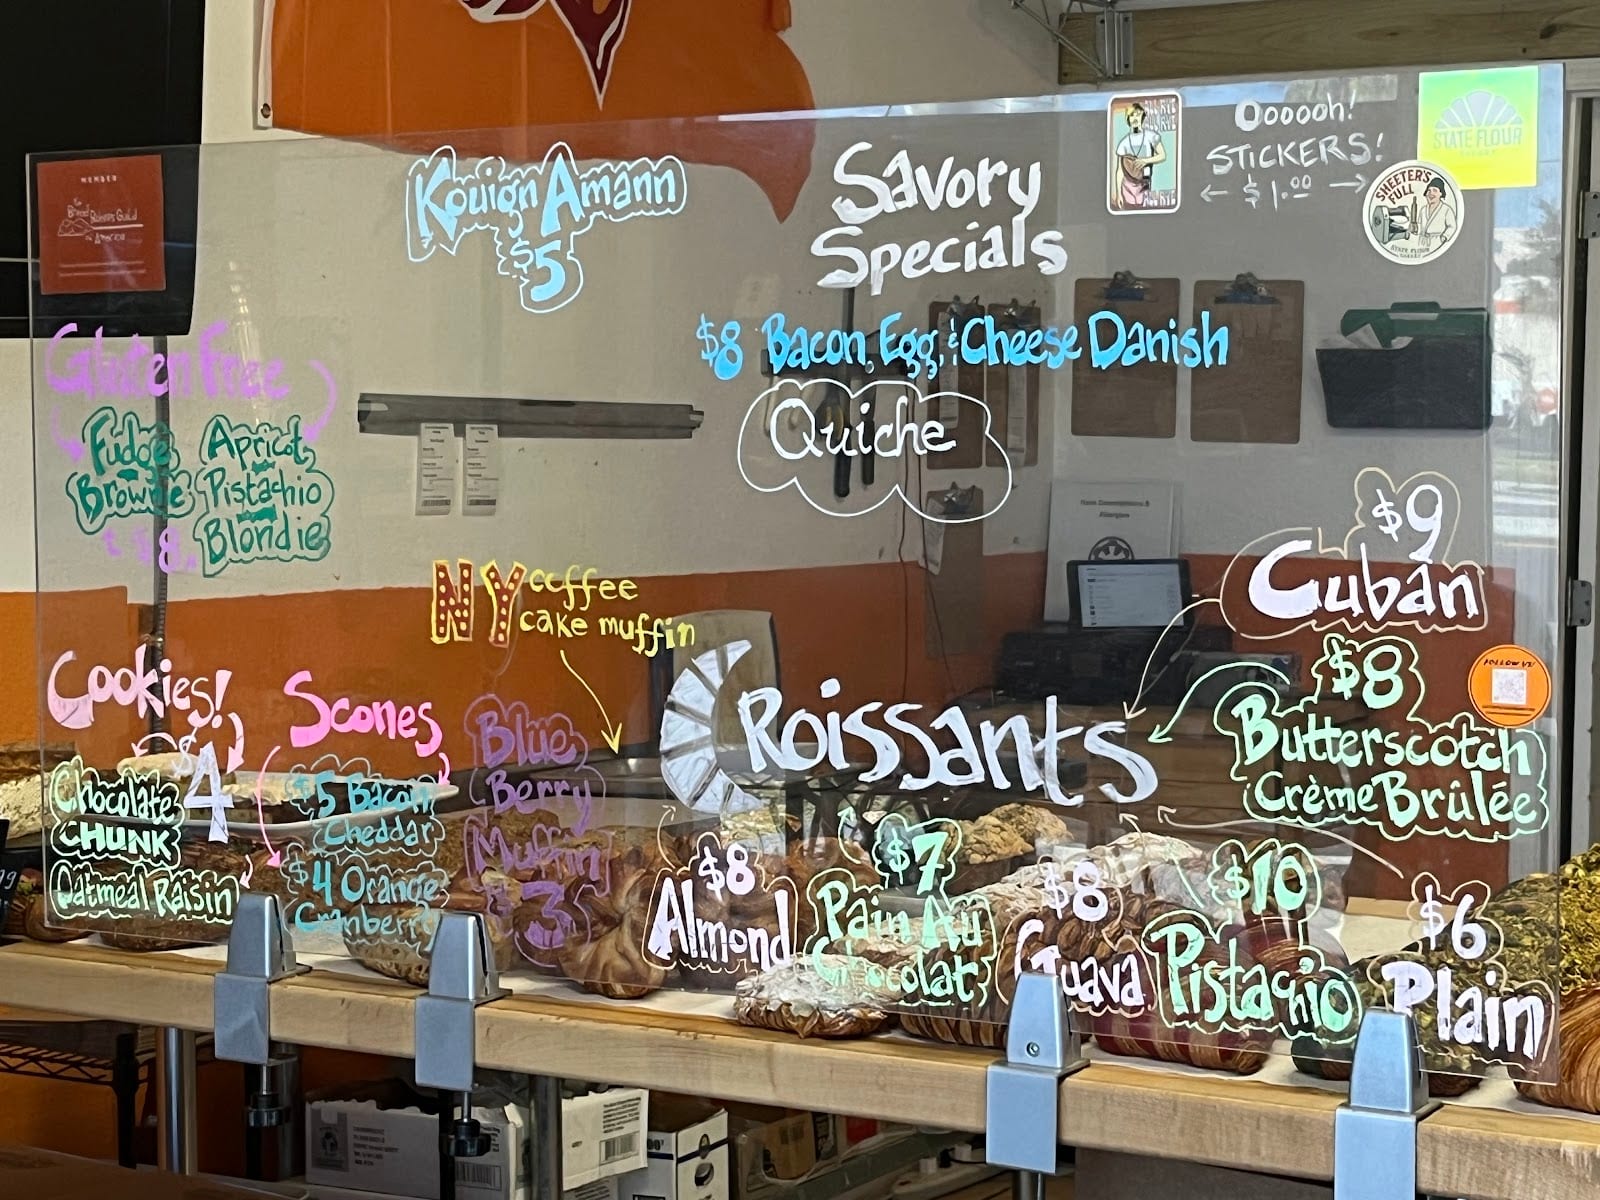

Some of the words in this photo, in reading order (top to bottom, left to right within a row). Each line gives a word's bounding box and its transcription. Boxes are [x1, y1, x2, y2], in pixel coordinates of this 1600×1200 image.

[1433, 129, 1473, 150] STATE
[1476, 126, 1522, 148] FLOUR
[414, 157, 538, 248] Kouign
[540, 153, 677, 237] Amann
[832, 141, 1042, 225] Savory
[1388, 184, 1414, 205] FULL
[510, 239, 566, 302] $5
[810, 225, 1068, 296] Specials
[696, 313, 743, 380] $8
[961, 315, 1083, 369] Cheese
[1088, 310, 1229, 370] Danish
[207, 418, 307, 471] Apricot
[770, 395, 957, 460] Quiche
[76, 473, 185, 525] Browne
[203, 468, 322, 508] Pistachio
[203, 510, 325, 564] Blondie
[1371, 483, 1443, 565] $9
[431, 559, 528, 648] NY
[529, 564, 639, 611] coffee
[1248, 539, 1480, 621] Cuban
[519, 609, 589, 638] cake
[598, 613, 696, 658] muffin
[47, 643, 233, 730] Cookies!
[1328, 636, 1404, 709] $8
[283, 670, 443, 758] Scones
[1231, 693, 1531, 776] Butterscotch
[54, 766, 177, 825] Chocolate
[348, 774, 431, 814] Bacon
[488, 770, 592, 837] Berry
[1254, 770, 1378, 814] Crème
[1371, 769, 1538, 828] Brûlée
[58, 821, 172, 857] CHUNK
[324, 818, 437, 847] Cheddar
[887, 826, 948, 896] $7
[56, 863, 151, 911] Oatmeal
[153, 876, 232, 916] Raisin
[288, 860, 333, 907] $4
[341, 866, 441, 904] Orange
[697, 842, 756, 902] $8
[1043, 861, 1109, 922] $8
[1223, 849, 1308, 915] $10
[647, 876, 794, 972] Almond
[816, 880, 911, 943] Pain
[1420, 884, 1487, 960] $6
[1381, 960, 1545, 1061] Plain
